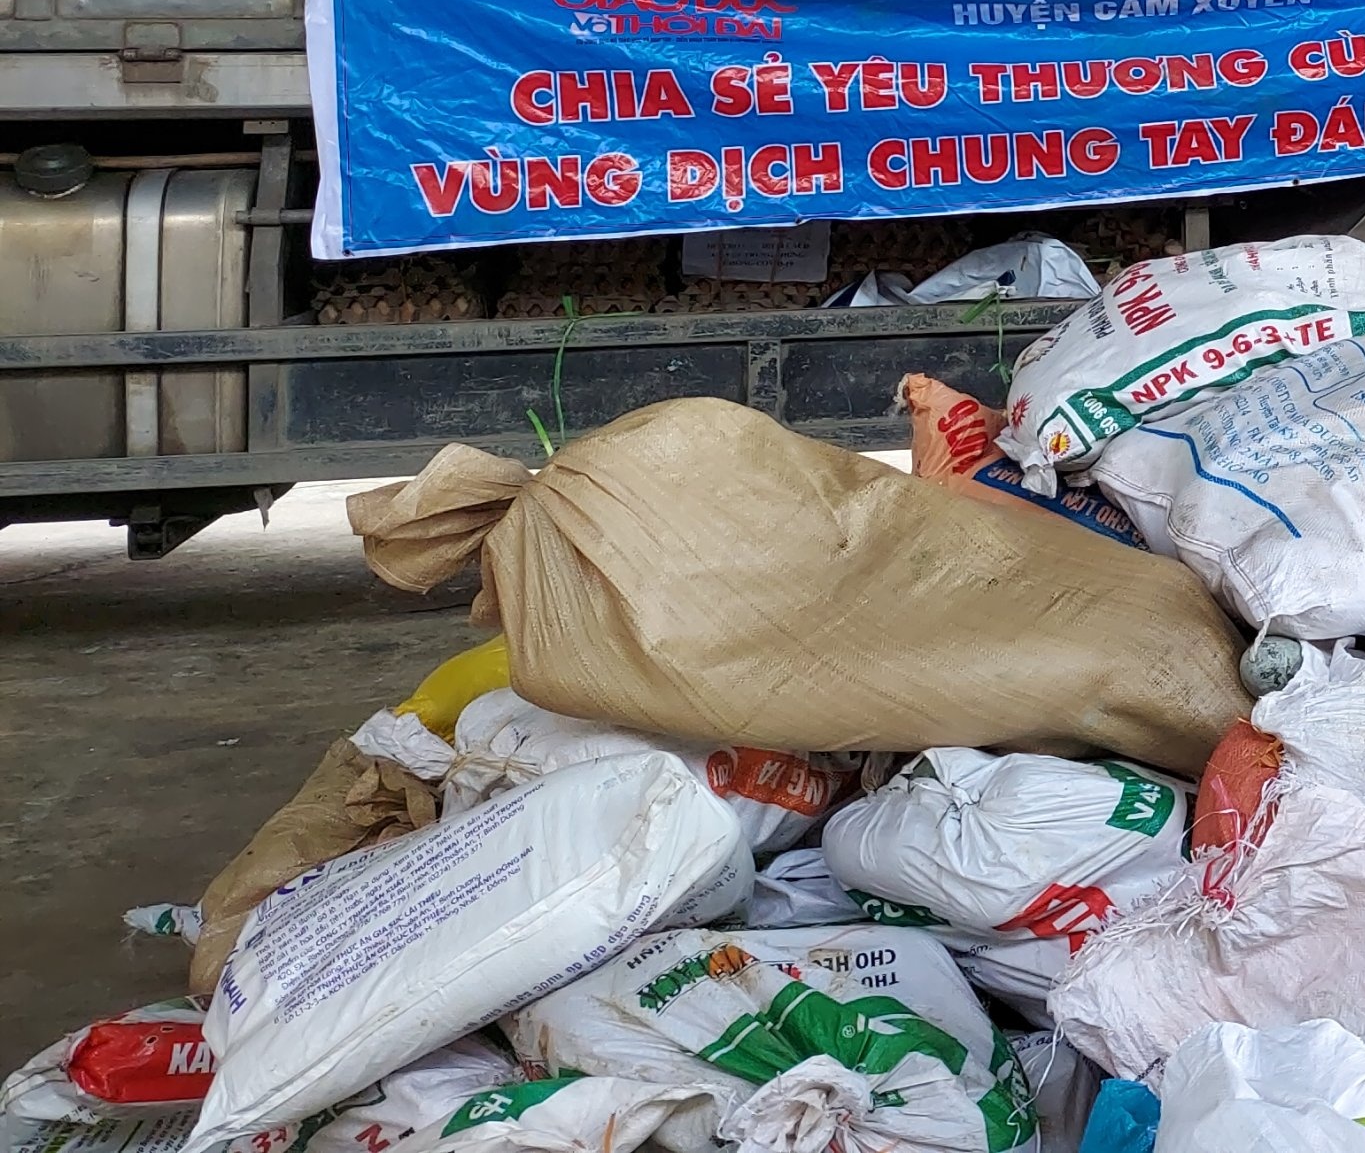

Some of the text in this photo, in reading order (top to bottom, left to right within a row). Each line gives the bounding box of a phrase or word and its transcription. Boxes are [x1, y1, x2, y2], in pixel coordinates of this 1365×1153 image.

[953, 0, 1080, 30] HUYỆN
[511, 67, 695, 126] CHIA
[711, 51, 795, 118] SẺ
[810, 55, 949, 113] YÊU
[970, 46, 1268, 106] THƯƠNG
[410, 147, 643, 218] VÙNG
[667, 143, 844, 214] DỊCH
[867, 125, 1122, 192] CHUNG
[1140, 112, 1258, 171] TAY
[1117, 282, 1177, 337] NPK
[1129, 360, 1200, 405] NPK
[1080, 390, 1121, 436] ISO 9001
[855, 949, 897, 970] CHO
[166, 1041, 217, 1076] KA
